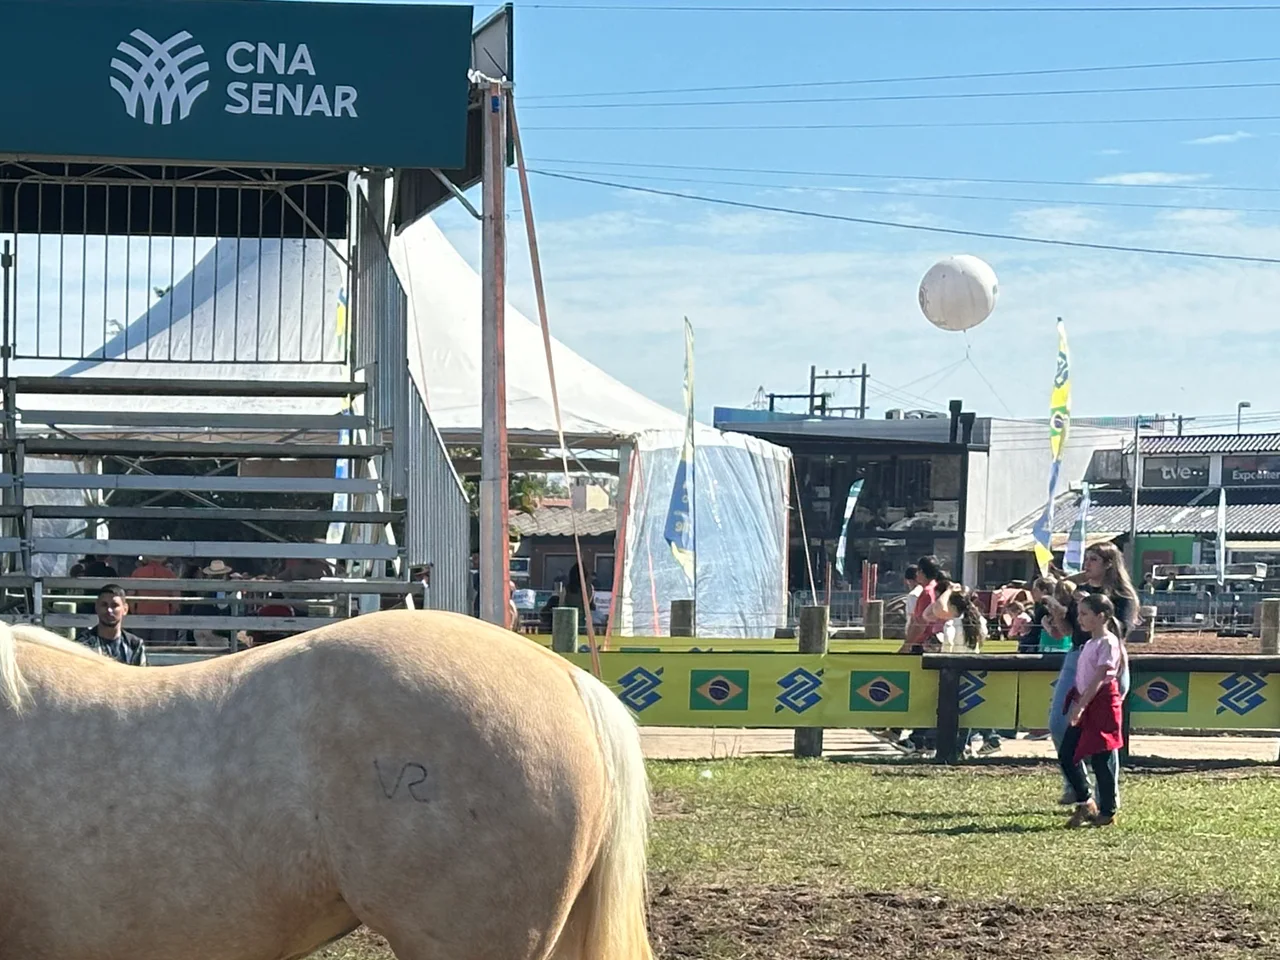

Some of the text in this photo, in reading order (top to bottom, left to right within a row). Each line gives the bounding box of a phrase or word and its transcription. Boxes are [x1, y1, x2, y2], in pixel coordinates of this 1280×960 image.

[225, 41, 316, 75] CNA
[224, 81, 358, 118] SENAR
[1161, 465, 1191, 480] tve
